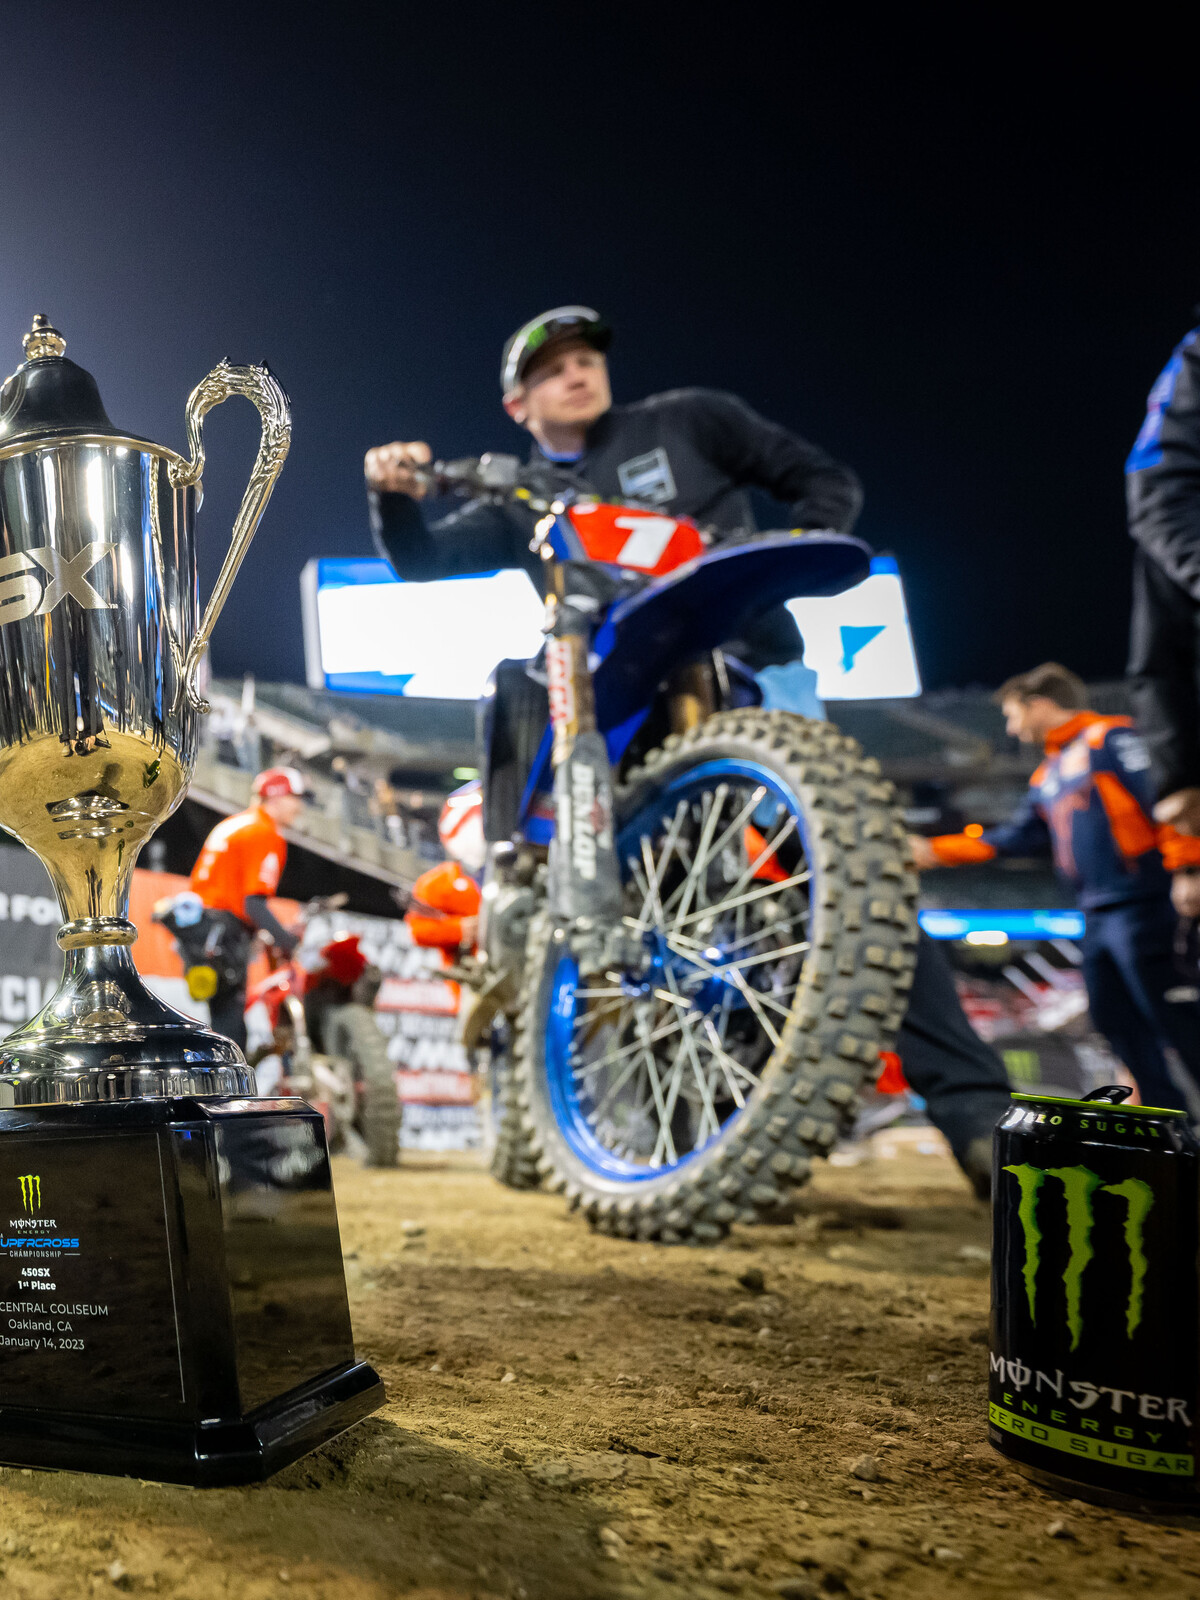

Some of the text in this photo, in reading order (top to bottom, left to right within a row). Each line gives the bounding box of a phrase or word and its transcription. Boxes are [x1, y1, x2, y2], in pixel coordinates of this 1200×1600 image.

[571, 762, 598, 881] DUNLOP
[1079, 1118, 1161, 1138] SUGAR
[9, 1250, 62, 1258] CHAMPIONSHIP
[21, 1267, 51, 1277] 450SX
[17, 1280, 56, 1290] 1st Place
[49, 1303, 109, 1316] COLISEUM
[8, 1318, 73, 1333] Oakland, CA
[0, 1335, 85, 1350] January 14, 2023
[1003, 1391, 1163, 1445] ENERGY
[990, 1406, 1049, 1441] ZERO
[1069, 1437, 1190, 1472] SUGAR
